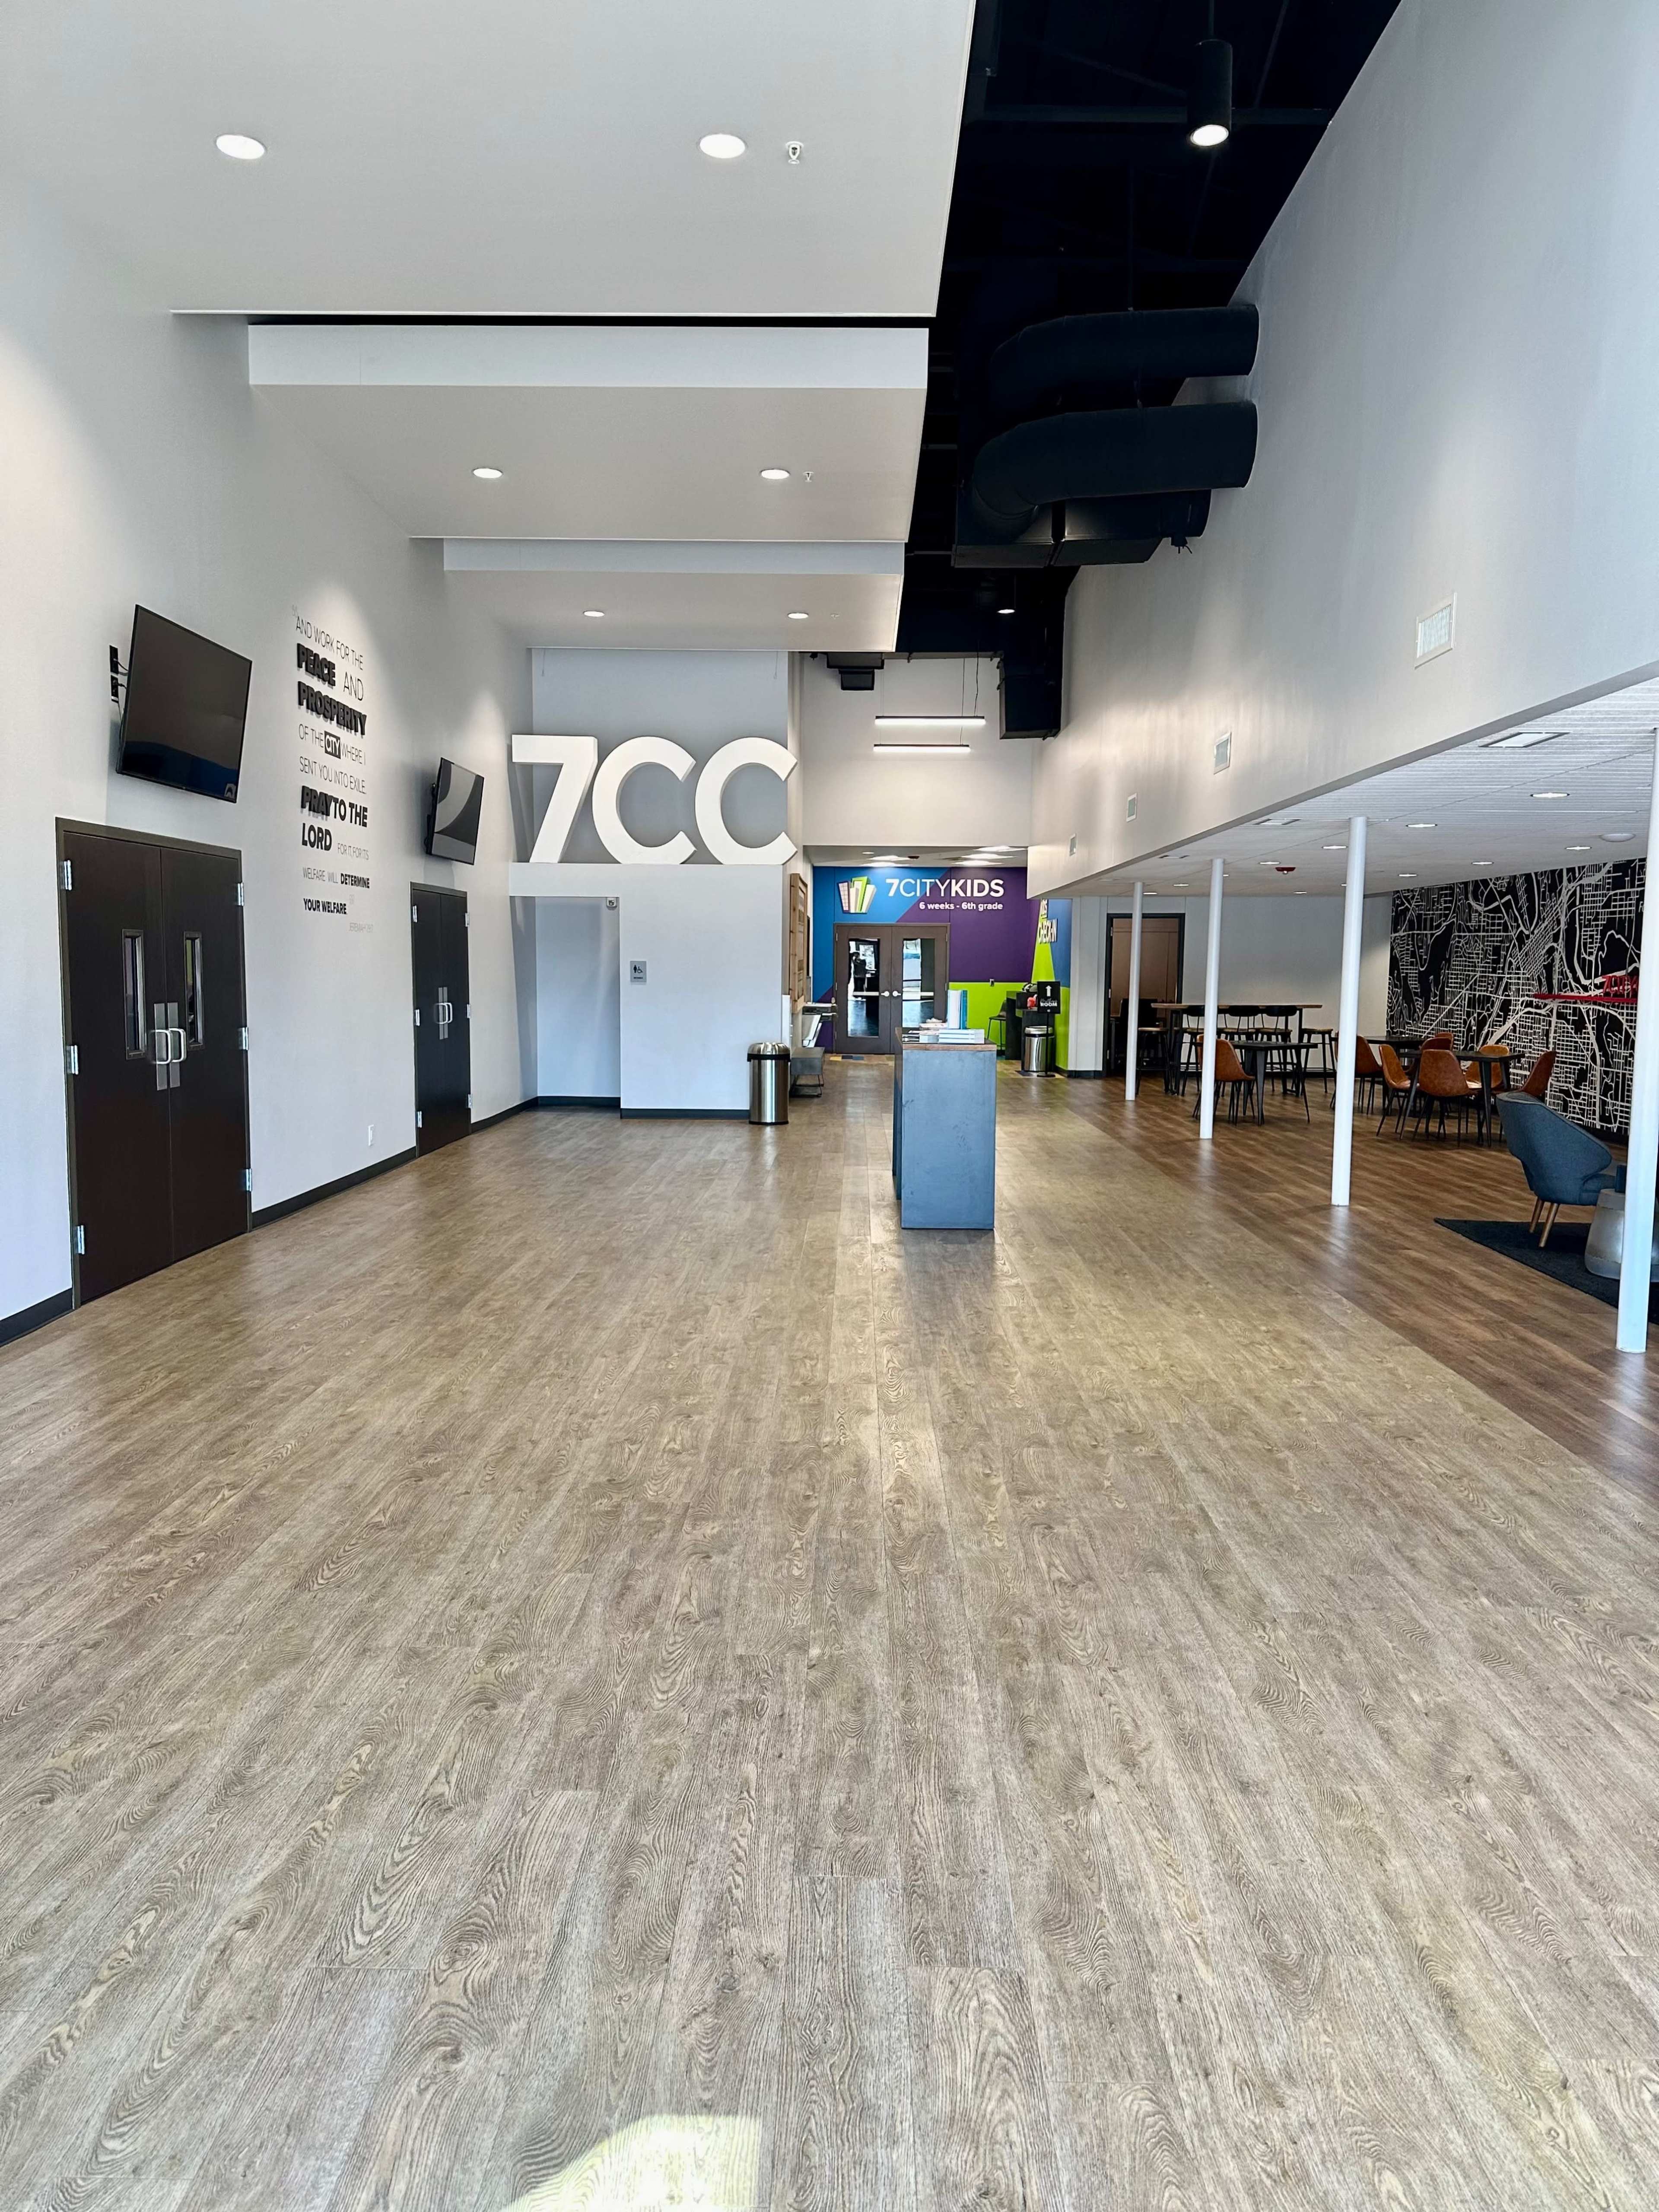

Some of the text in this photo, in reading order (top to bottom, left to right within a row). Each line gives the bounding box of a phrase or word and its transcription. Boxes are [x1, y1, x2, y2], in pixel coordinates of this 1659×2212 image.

[296, 616, 363, 671] AND WORK FOR THE
[297, 643, 364, 701] PEACE AND
[298, 681, 367, 735] PROSPERITY
[299, 724, 308, 741] OF
[311, 728, 324, 748] THE
[325, 734, 340, 756] CITY
[341, 743, 362, 764] WHERE
[300, 756, 318, 776] SENT
[318, 763, 332, 782] YOU
[334, 769, 348, 788] INTO
[301, 785, 368, 827] PRAY TO THE
[512, 734, 798, 864] 7CC
[302, 822, 332, 851] LORD
[302, 867, 370, 889] WELFARE WILL DETERMINE
[885, 878, 1004, 897] 7CITYKIDS
[303, 898, 321, 912] YOUR
[927, 902, 954, 910] weeks
[961, 902, 976, 910] 6th
[978, 902, 1003, 912] grade
